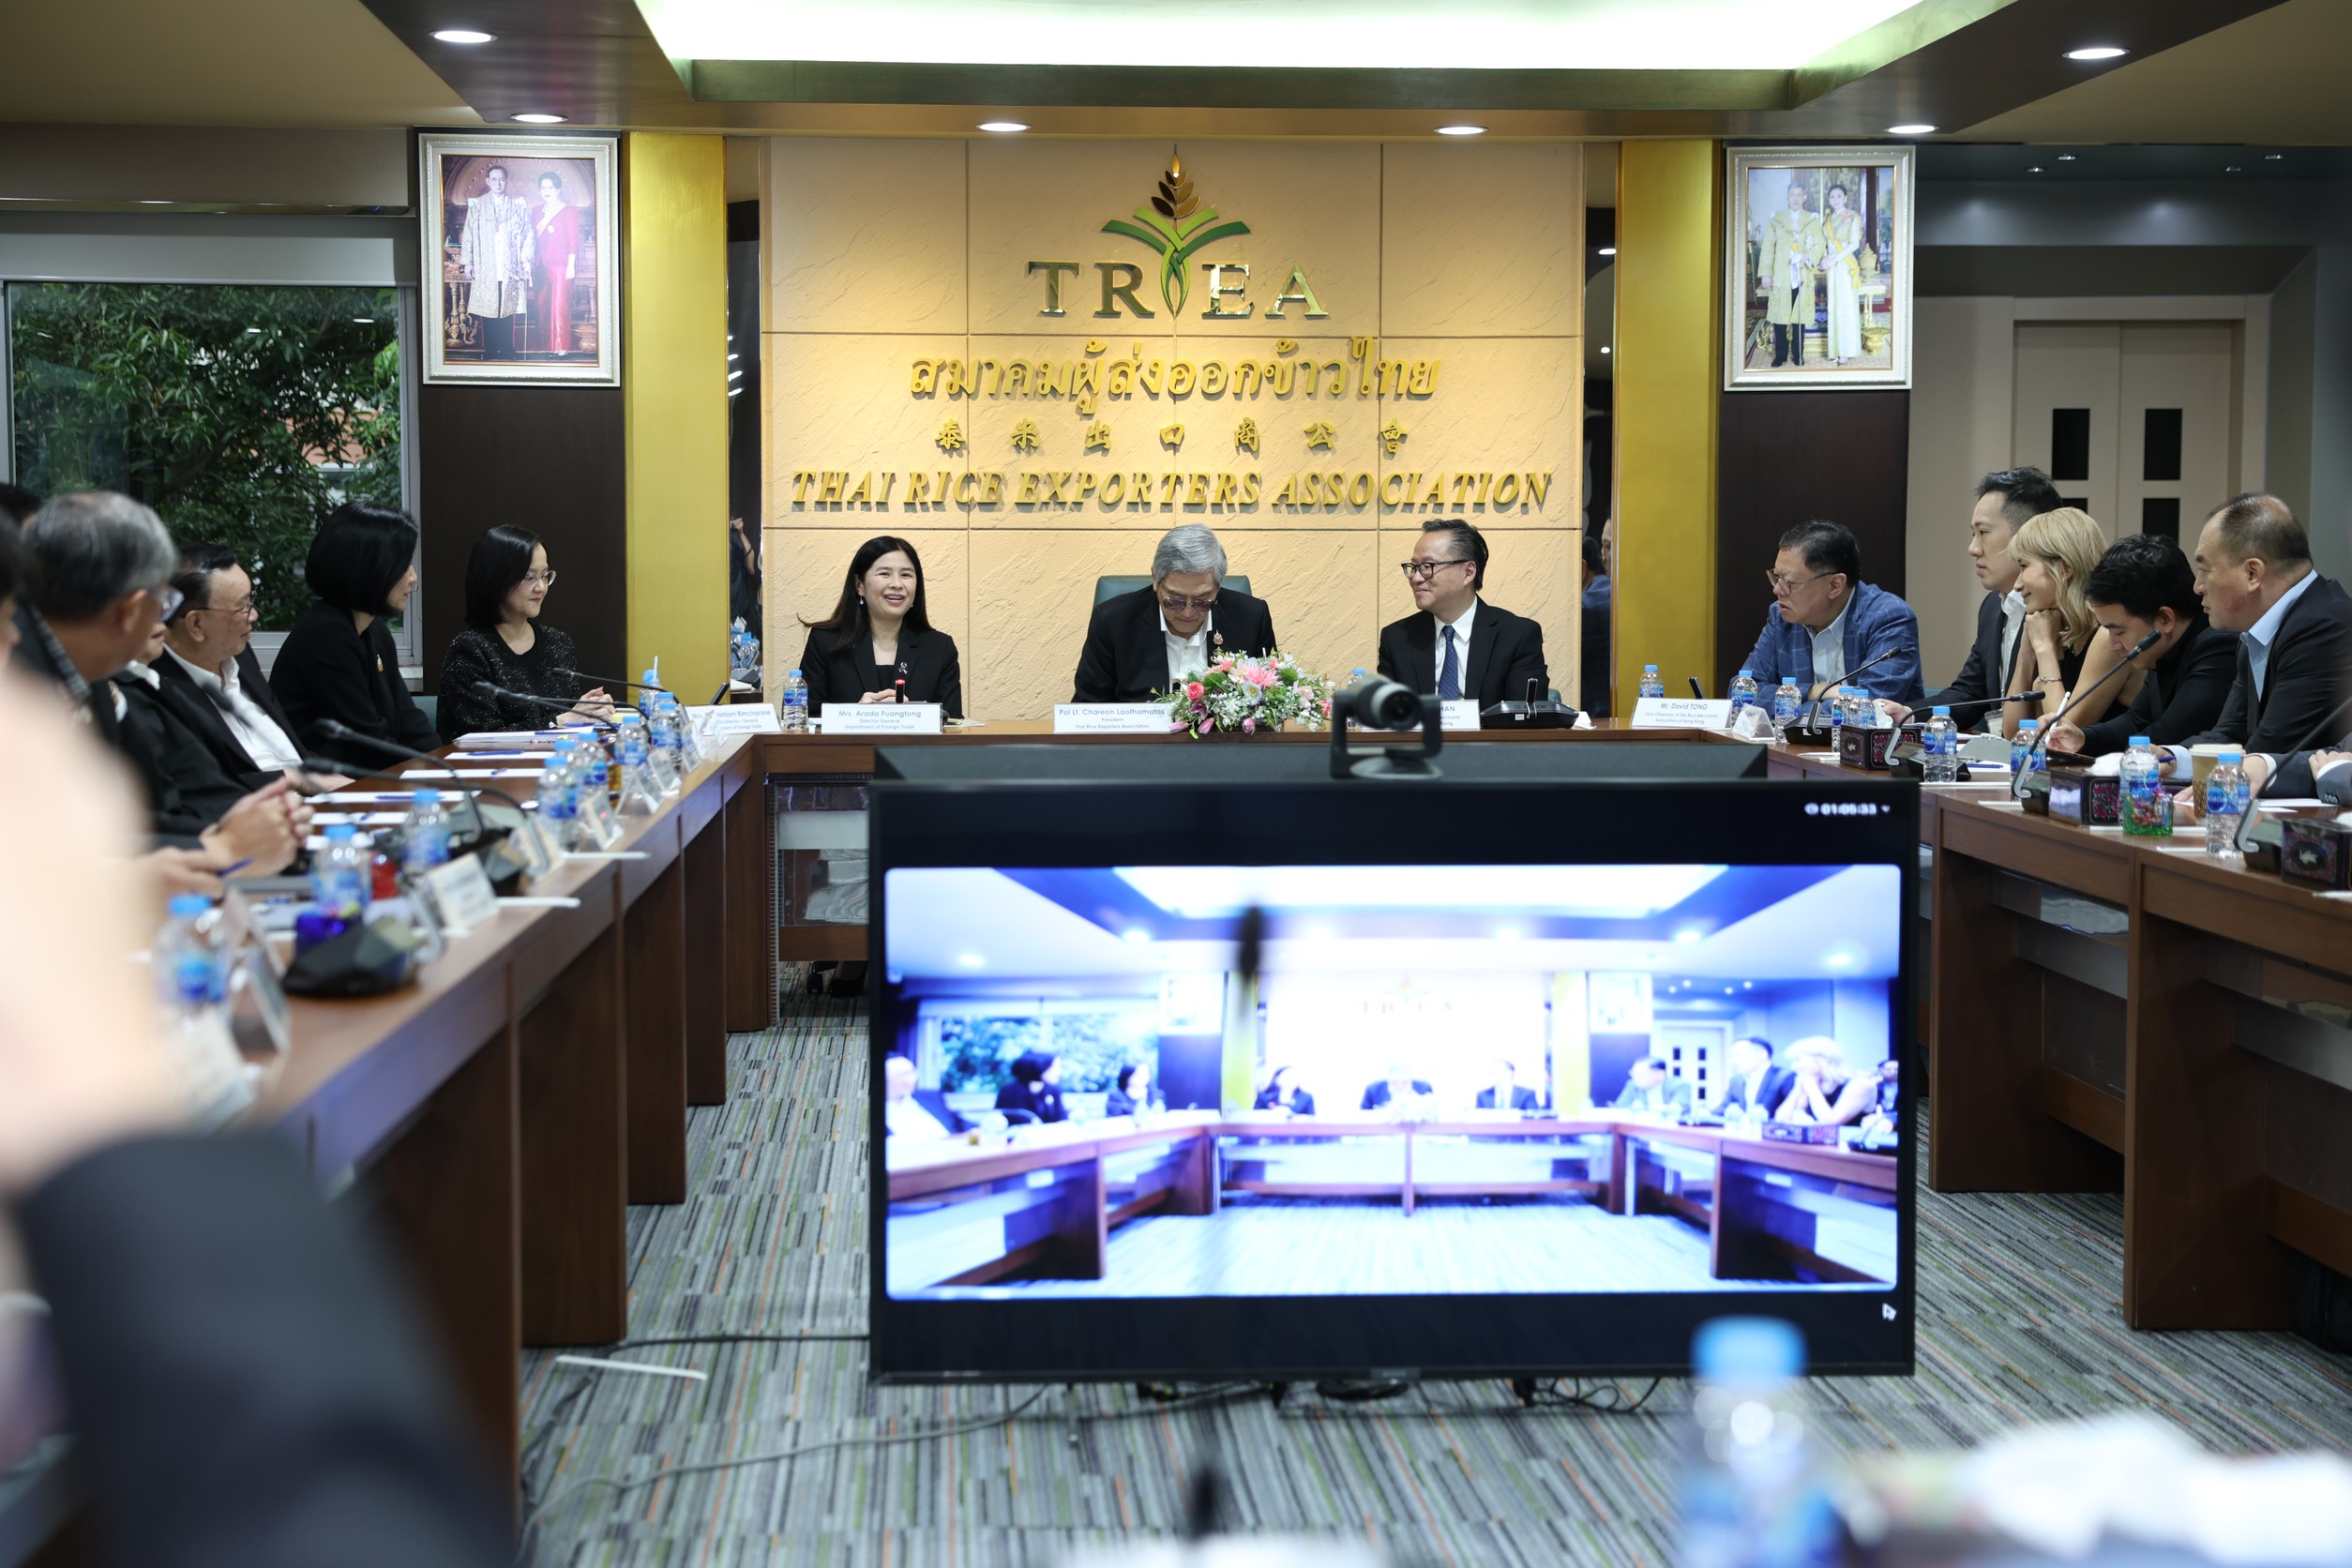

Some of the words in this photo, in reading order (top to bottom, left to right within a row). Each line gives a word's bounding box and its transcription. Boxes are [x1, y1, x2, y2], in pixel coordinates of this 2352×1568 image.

[911, 335, 1440, 415] สมาคมผู้ส่งออกข้าวไทย
[792, 471, 895, 504] THAI
[903, 471, 1003, 505] RICE
[1014, 472, 1262, 505] EXPORTERS
[1272, 472, 1552, 505] ASSOCIATION
[882, 710, 922, 718] Fuangtong
